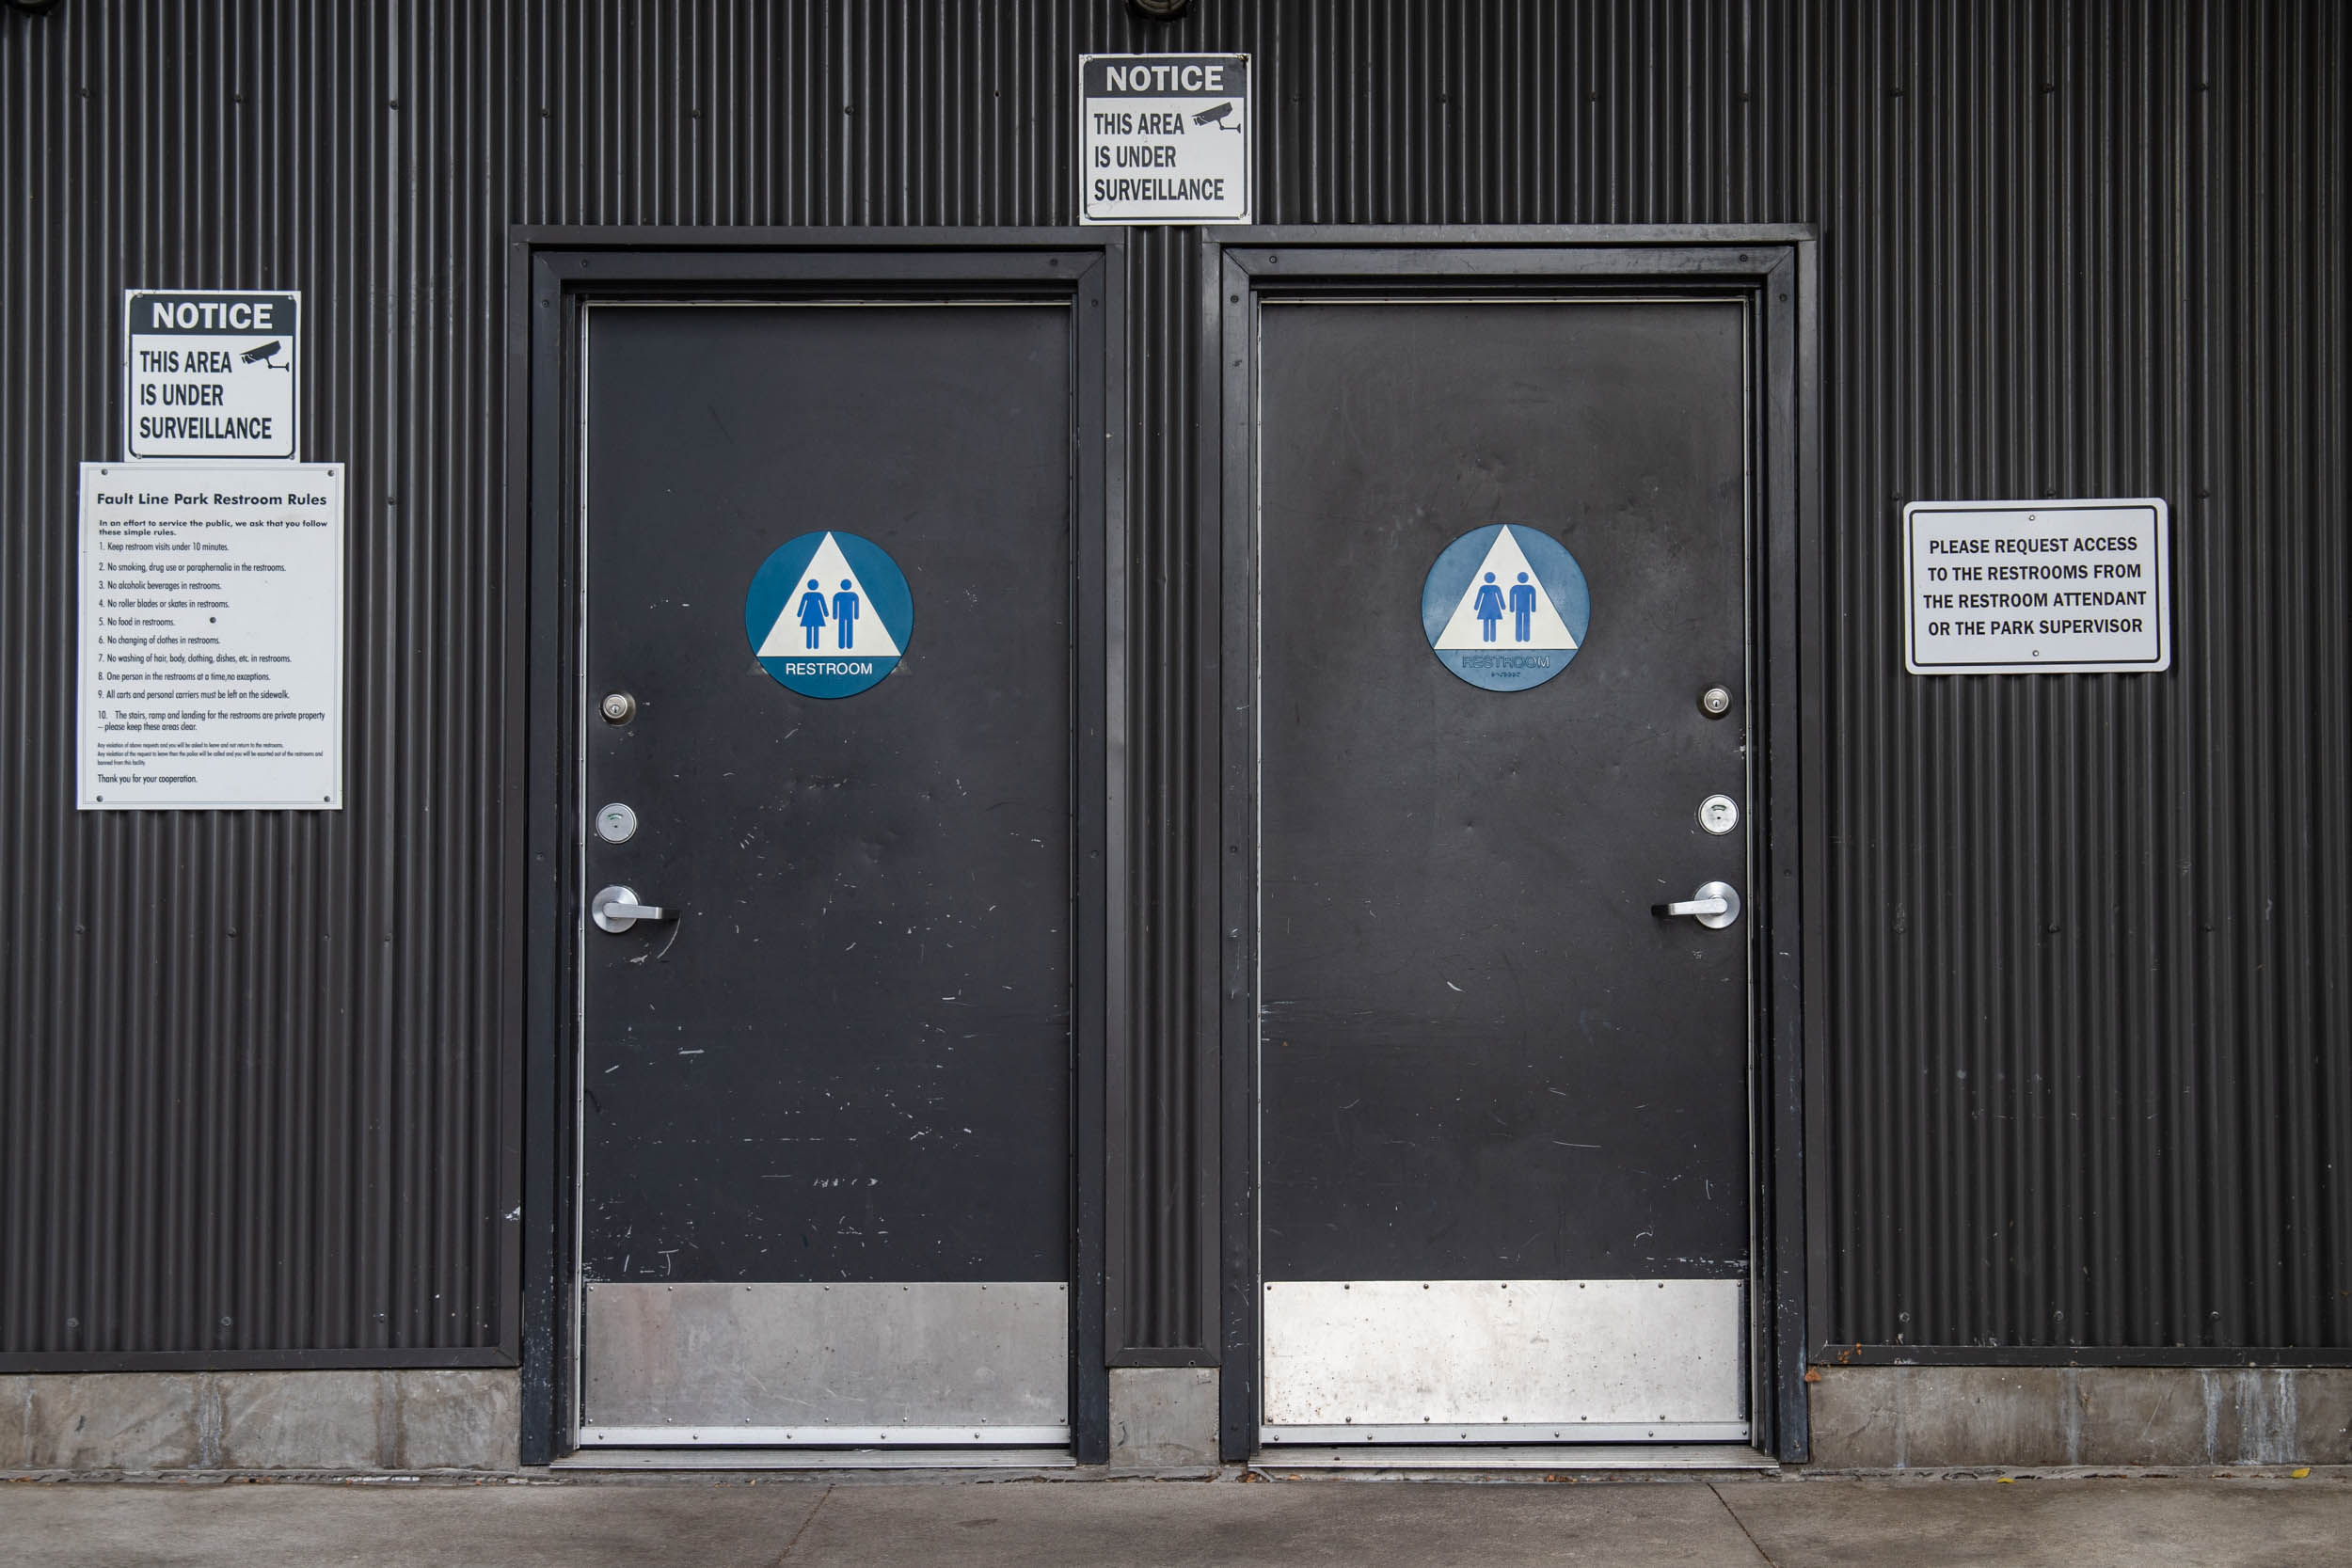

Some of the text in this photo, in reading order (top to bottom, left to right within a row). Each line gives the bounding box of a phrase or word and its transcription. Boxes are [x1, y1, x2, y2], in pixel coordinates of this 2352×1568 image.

[1107, 66, 1223, 91] NOTICE
[1094, 113, 1184, 135] THIS AREA
[1095, 146, 1176, 167] IS UNDER
[1094, 179, 1224, 201] SURVEILLANCE
[153, 303, 273, 329] NOTICE
[140, 351, 231, 372] THIS AREA
[141, 384, 223, 405] IS UNDER
[139, 417, 272, 439] SURVEILLANCE
[98, 493, 326, 505] Fault Line Park Restroom Rules
[124, 529, 151, 537] simple
[100, 542, 105, 550] 1.
[107, 542, 124, 552] Keep
[171, 542, 190, 551] under
[193, 542, 200, 551] 10
[202, 543, 229, 551] minutes.
[1931, 536, 2137, 555] PLEASE REQUEST ACCESS
[99, 562, 104, 571] 2.
[107, 562, 117, 571] No
[119, 562, 147, 573] smoking,
[149, 562, 164, 573] drug
[186, 562, 231, 573] paraphernalia
[242, 562, 252, 571] the
[1928, 564, 2140, 581] TO THE RESTROOMS FROM
[99, 580, 104, 589] 3.
[107, 580, 117, 589] No
[119, 580, 146, 589] alcoholic
[147, 580, 180, 592] beverages
[99, 599, 104, 608] 4.
[107, 599, 117, 608] No
[119, 598, 135, 608] roller
[137, 598, 158, 608] blades
[167, 599, 187, 608] skates
[1923, 591, 2147, 609] THE RESTROOM ATTENDANT
[99, 617, 104, 626] 5.
[107, 617, 117, 626] No
[119, 617, 133, 626] food
[1929, 619, 2142, 636] OR THE PARK SUPERVISOR
[119, 636, 147, 645] changing
[149, 635, 155, 643] of
[157, 635, 179, 643] clothes
[99, 654, 104, 662] 7.
[107, 654, 117, 662] No
[119, 654, 144, 664] washing
[146, 653, 152, 662] of
[154, 654, 167, 663] hair,
[169, 654, 186, 664] body,
[188, 654, 215, 664] clothing,
[216, 654, 237, 662] dishes,
[1462, 655, 1550, 668] RESTROOM
[786, 662, 873, 675] RESTROOM
[98, 672, 103, 680] 8.
[107, 672, 120, 681] One
[152, 672, 163, 680] the
[236, 673, 271, 682] exceptions.
[106, 689, 115, 698] All
[133, 689, 145, 698] and
[147, 690, 174, 700] personal
[176, 690, 199, 699] carriers
[218, 689, 226, 698] be
[228, 689, 237, 698] left
[261, 689, 290, 698] sidewalk.
[98, 711, 108, 721] 10.
[115, 710, 127, 721] The
[128, 711, 147, 722] stairs,
[167, 710, 180, 719] and
[182, 710, 205, 722] landing
[207, 710, 216, 719] for
[218, 710, 228, 719] the
[275, 711, 297, 721] private
[298, 712, 326, 721] property
[104, 722, 125, 732] please
[127, 722, 142, 732] keep
[143, 721, 160, 730] these
[98, 774, 118, 783] Thank
[132, 773, 141, 783] for
[159, 775, 197, 784] cooperation.
